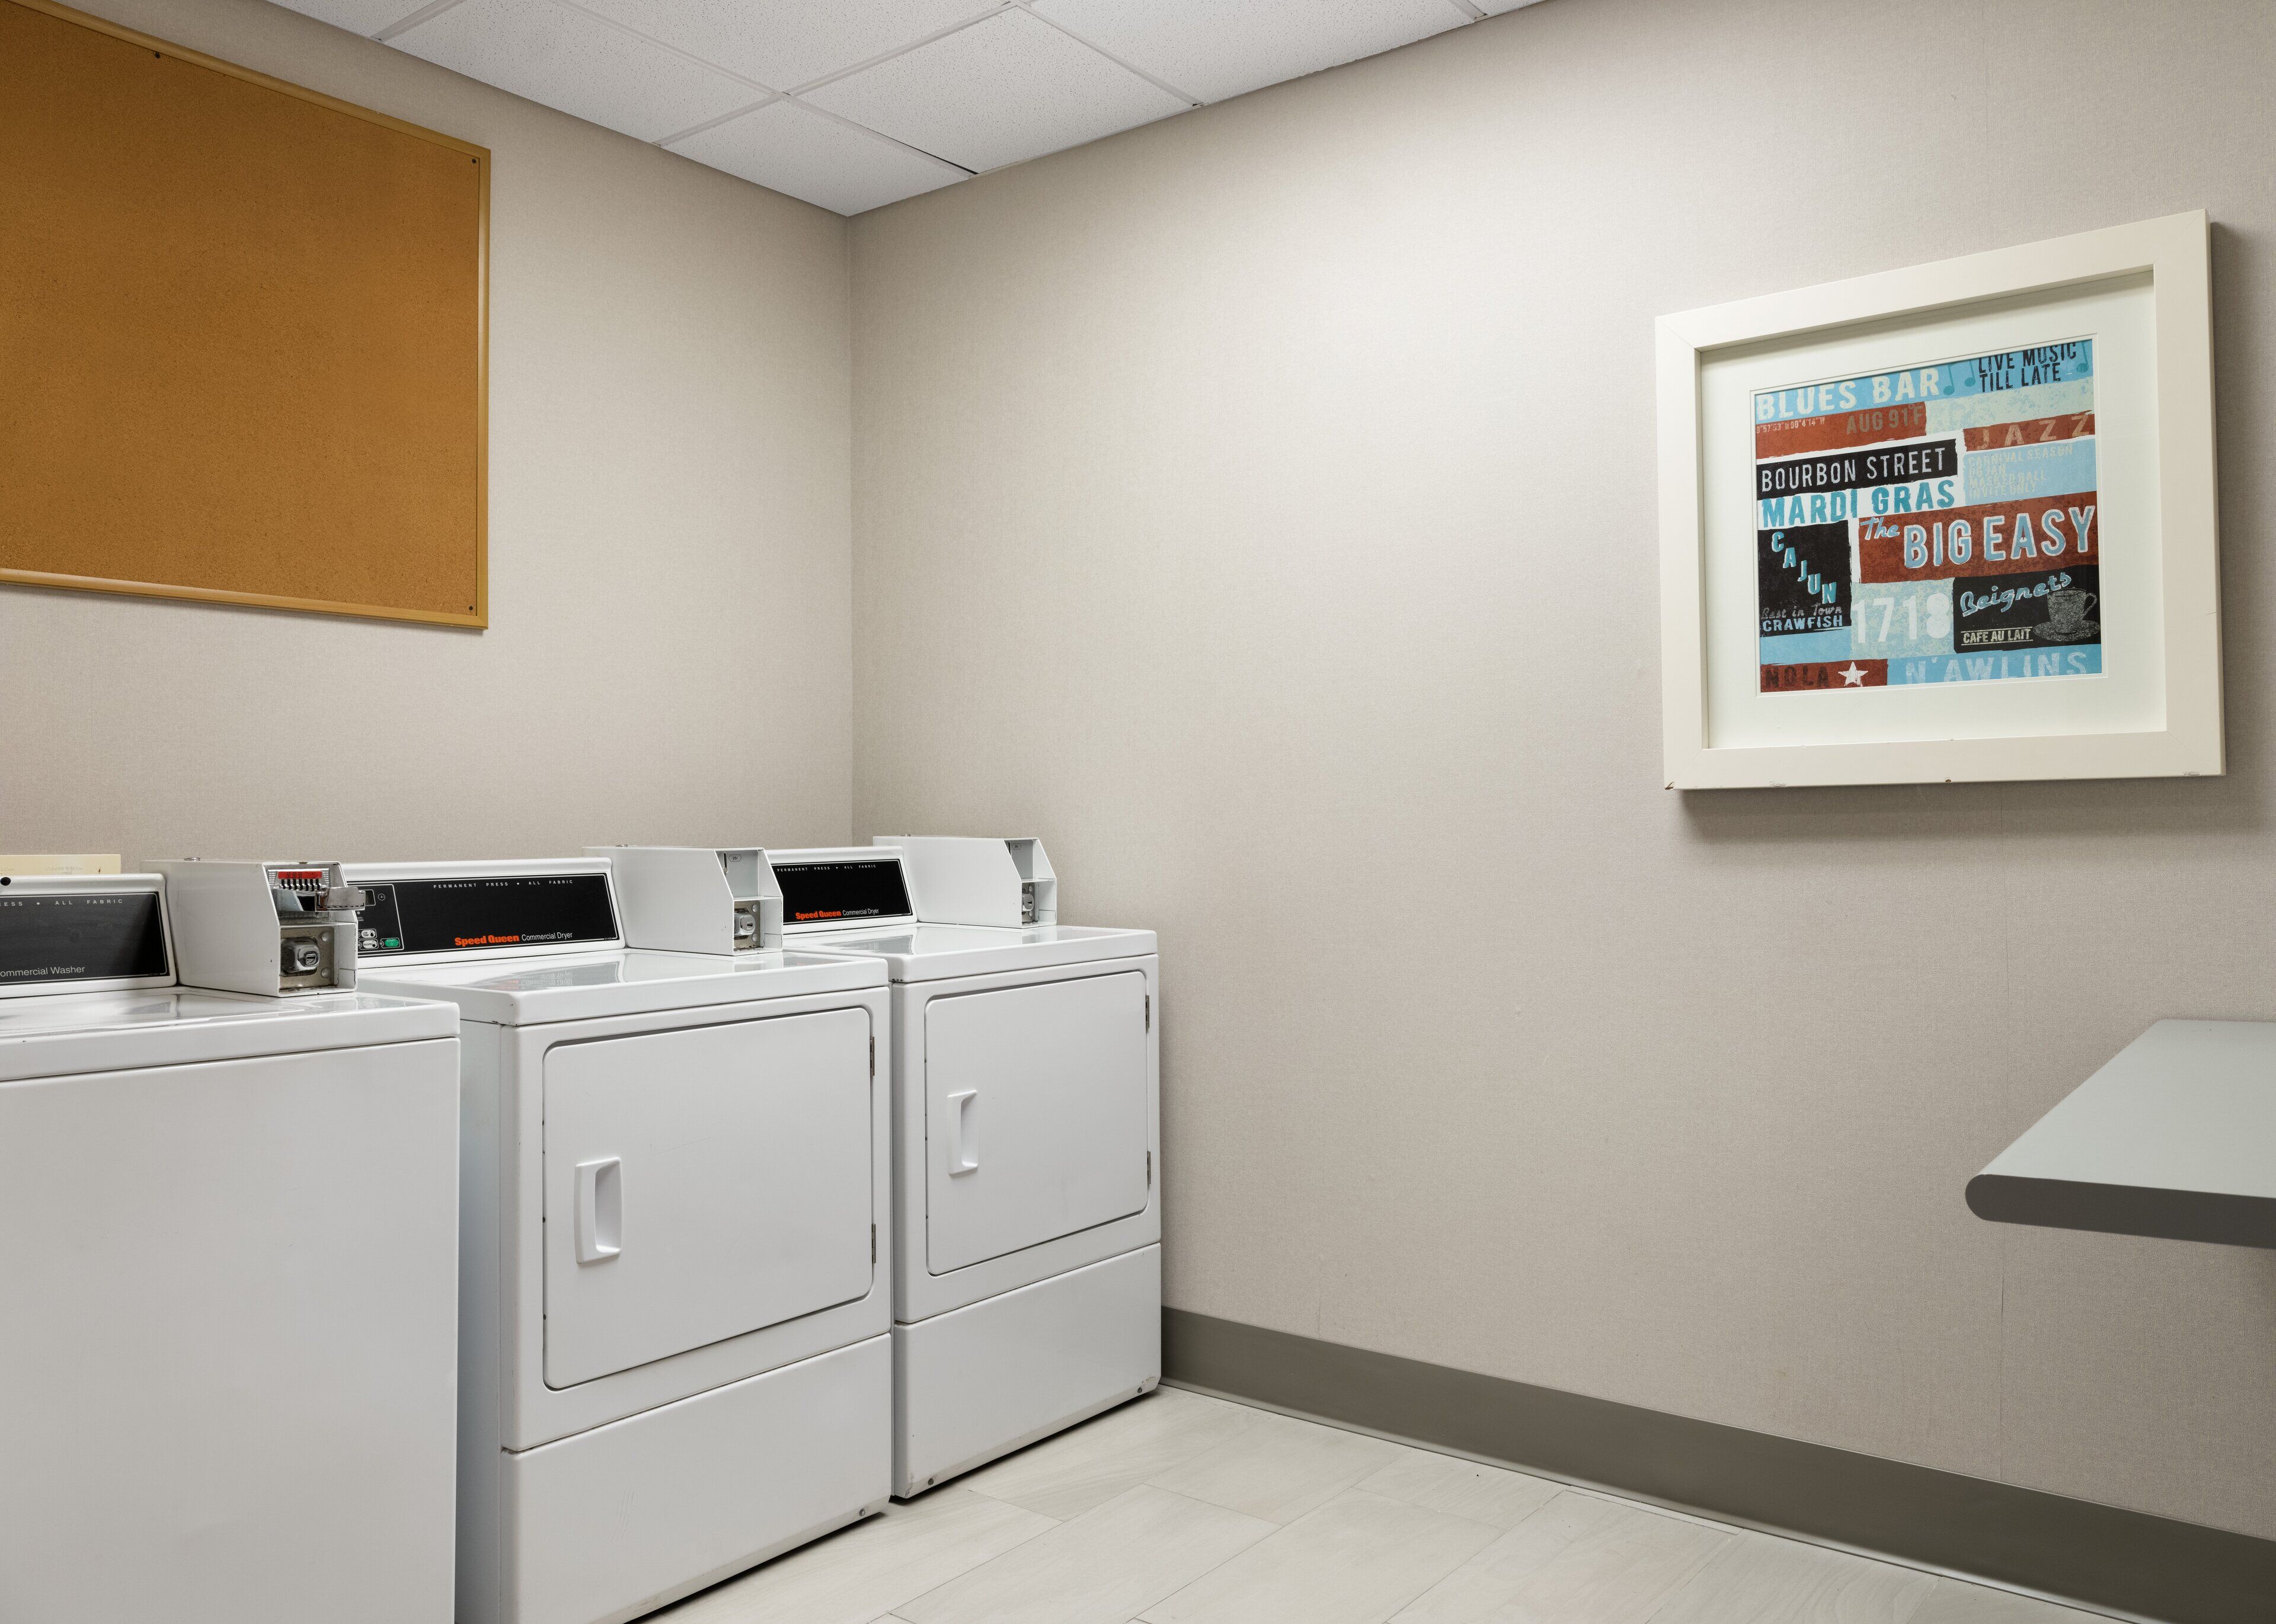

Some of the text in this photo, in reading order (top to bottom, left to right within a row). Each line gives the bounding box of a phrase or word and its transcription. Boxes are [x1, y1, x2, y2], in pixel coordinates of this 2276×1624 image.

[1978, 342, 2076, 373] LIVE MUSIC
[1980, 362, 2061, 392] TILL LATE
[1757, 368, 1939, 421] BLUES BAR
[1846, 411, 1883, 434] AUG
[1977, 415, 2089, 450] JAZZ
[1762, 447, 1945, 492] BOURBON STREET
[1968, 444, 2073, 466] CARNIVAL SEASON
[1762, 480, 1955, 528] MARDI GRAS
[1859, 506, 2096, 568] The BIG EASY
[1772, 532, 1836, 604] CAJUN
[1811, 602, 1842, 616] Town
[1960, 572, 2072, 617] Beignets
[1762, 615, 1843, 632] CRAWFISH
[1852, 593, 1950, 643] 1718
[1963, 629, 2031, 643] CAFE AU LAIT
[1766, 664, 1829, 688] NOLA
[1906, 652, 2087, 683] N'AWLINS
[795, 911, 819, 920] Speed
[455, 932, 573, 947] Speed Queen Commercial Dryer
[50, 966, 85, 974] Washer
